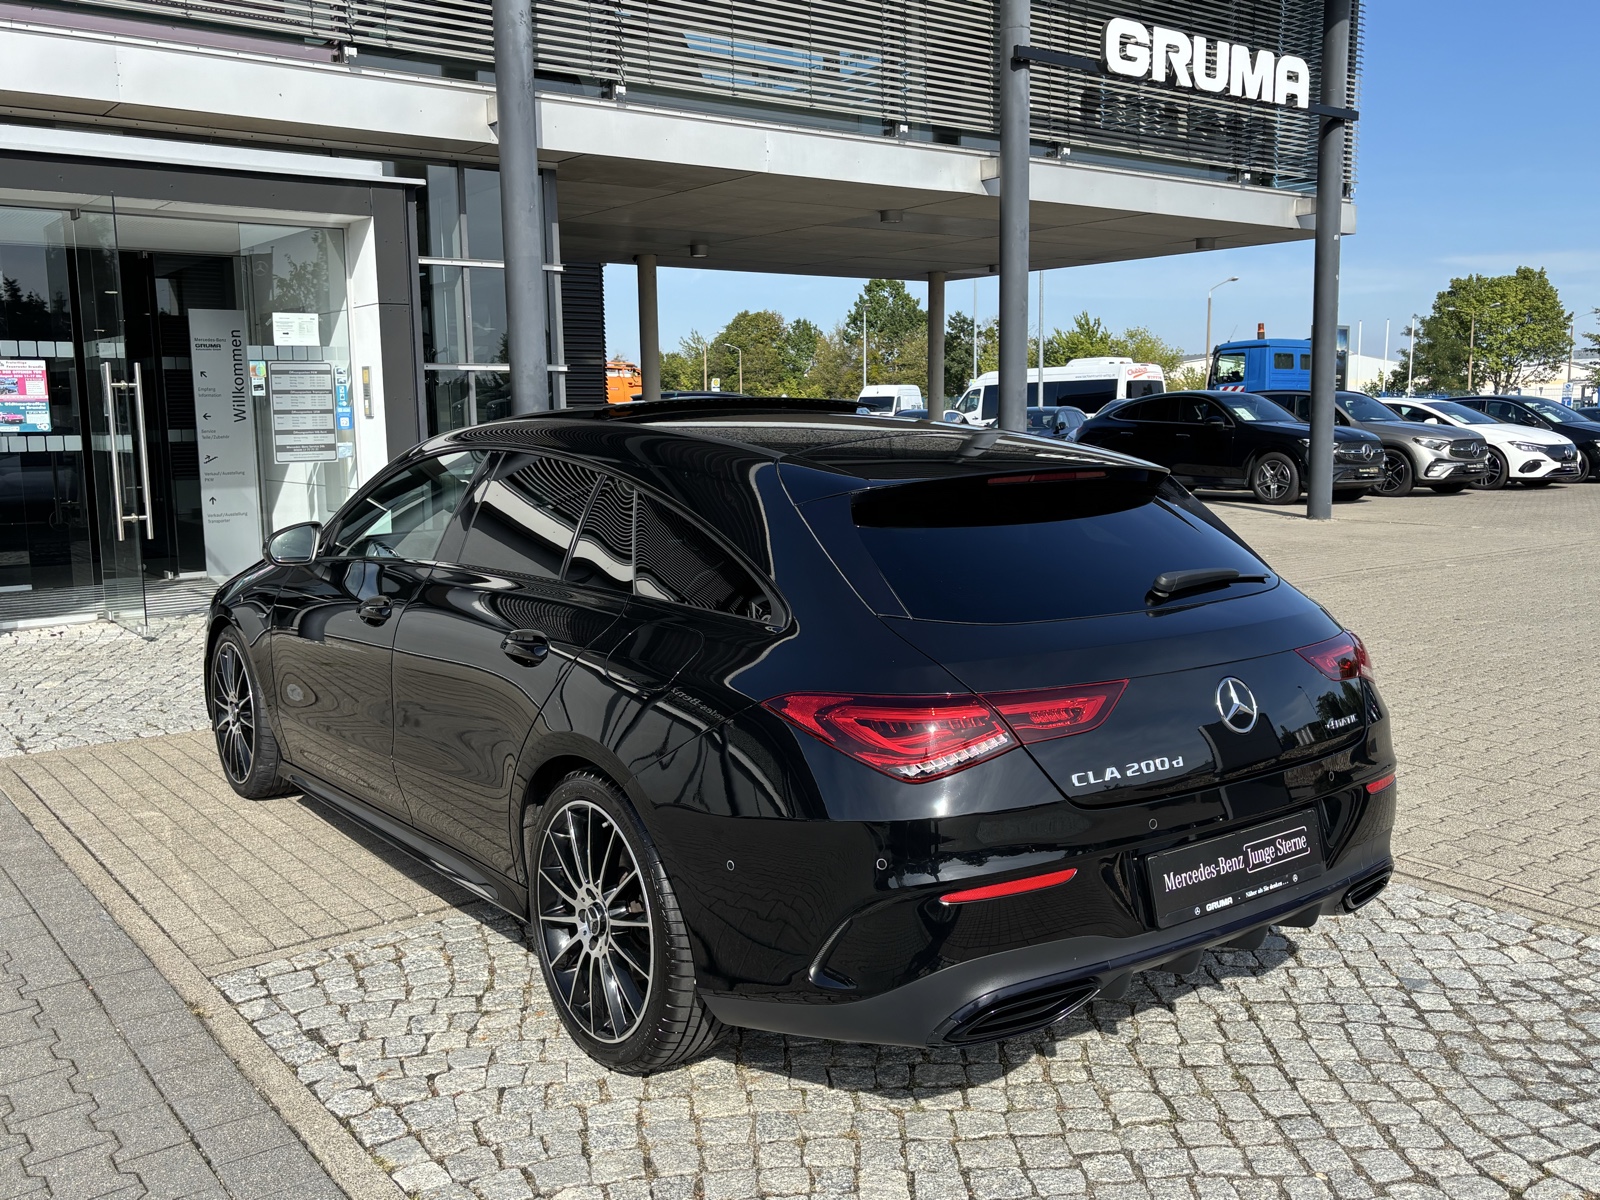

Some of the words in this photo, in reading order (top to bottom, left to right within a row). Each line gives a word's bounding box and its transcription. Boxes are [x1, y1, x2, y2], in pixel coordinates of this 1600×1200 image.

[1104, 17, 1310, 109] GRUMA
[231, 329, 247, 423] Willkommen
[1071, 766, 1122, 787] CLA
[1163, 854, 1245, 893] Mercedes-Benz
[1247, 844, 1276, 869] Junge
[1275, 834, 1308, 857] Sterne
[1205, 896, 1233, 912] GRUMA
